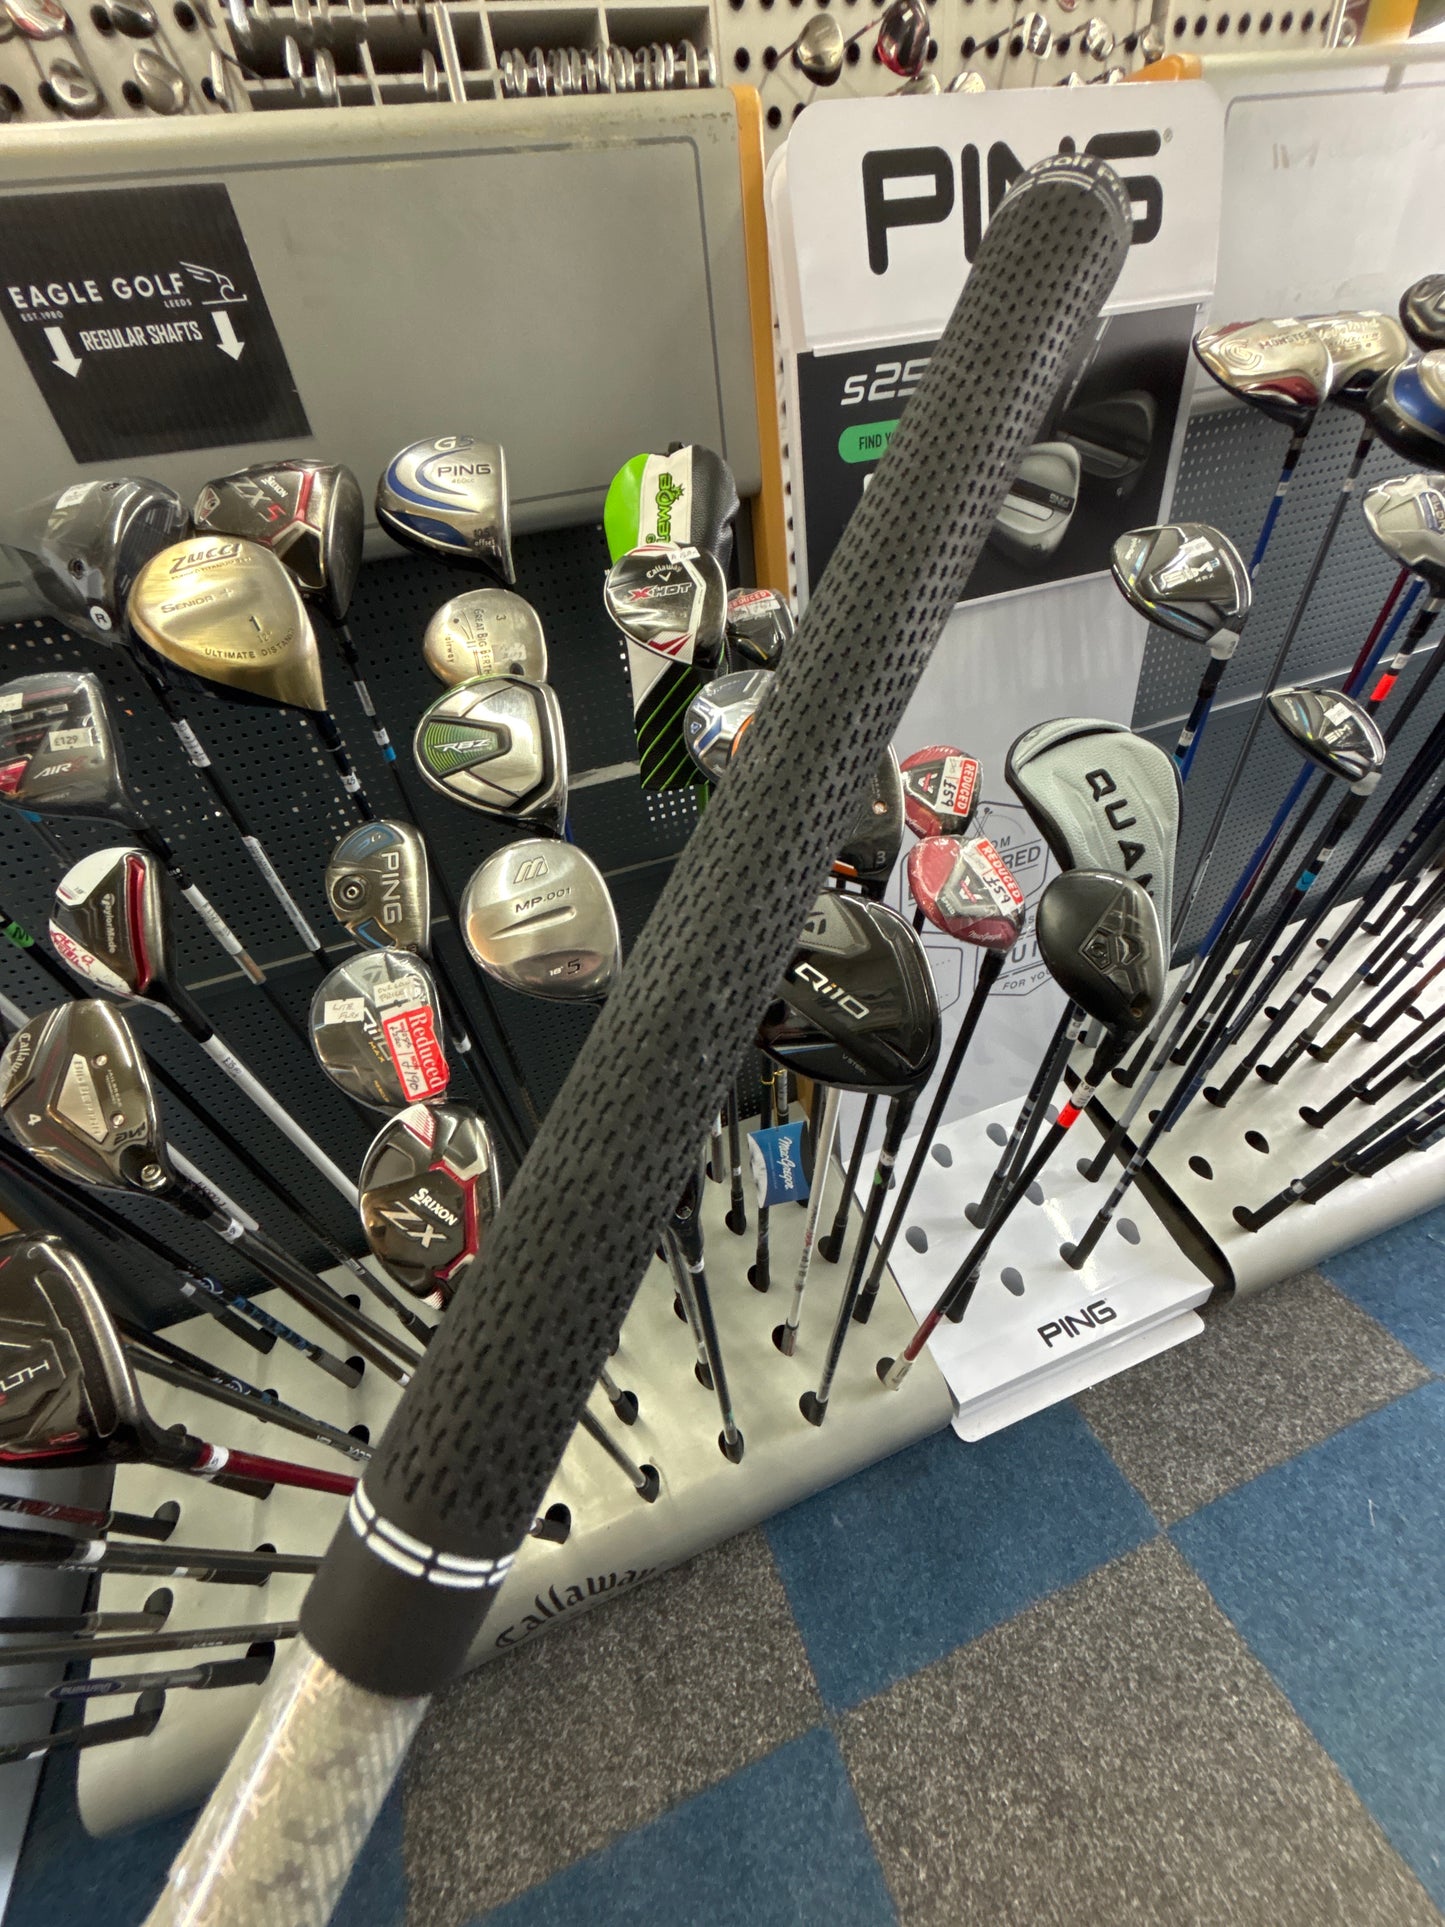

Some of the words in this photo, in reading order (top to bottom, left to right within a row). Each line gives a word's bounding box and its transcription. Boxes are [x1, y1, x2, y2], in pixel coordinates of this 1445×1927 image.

[7, 280, 103, 309] EAGLE
[112, 273, 184, 299] GOLF
[164, 298, 192, 308] LEEDS
[79, 326, 148, 351] REGULAR
[147, 321, 203, 345] SHAFTS
[859, 434, 882, 450] FIND
[437, 463, 491, 477] PING
[646, 564, 683, 578] Callaway
[94, 613, 108, 625] R
[249, 615, 262, 632] 1
[473, 608, 484, 631] GREAT
[477, 632, 488, 647] BIG
[204, 647, 256, 659] ULTIMATE
[54, 735, 78, 746] £129
[434, 739, 491, 753] RBZ
[941, 779, 957, 807] £59
[957, 763, 975, 810] REDUCED
[1085, 768, 1153, 897] QUA
[876, 850, 887, 864] 3
[982, 845, 1022, 900] REDUCED
[381, 851, 402, 924] PING
[983, 875, 1011, 904] £59
[567, 958, 581, 975] 5
[794, 962, 870, 1020] Qi10
[1003, 980, 1026, 991] FOR
[11, 1032, 31, 1073] Callaw
[368, 1041, 385, 1063] MAX
[408, 1012, 446, 1089] Reduced
[27, 1113, 42, 1126] 4
[777, 1135, 796, 1190] MacGregor
[409, 1187, 458, 1226] SRIXON
[380, 1201, 448, 1248] ZX
[1037, 1299, 1117, 1348] PING
